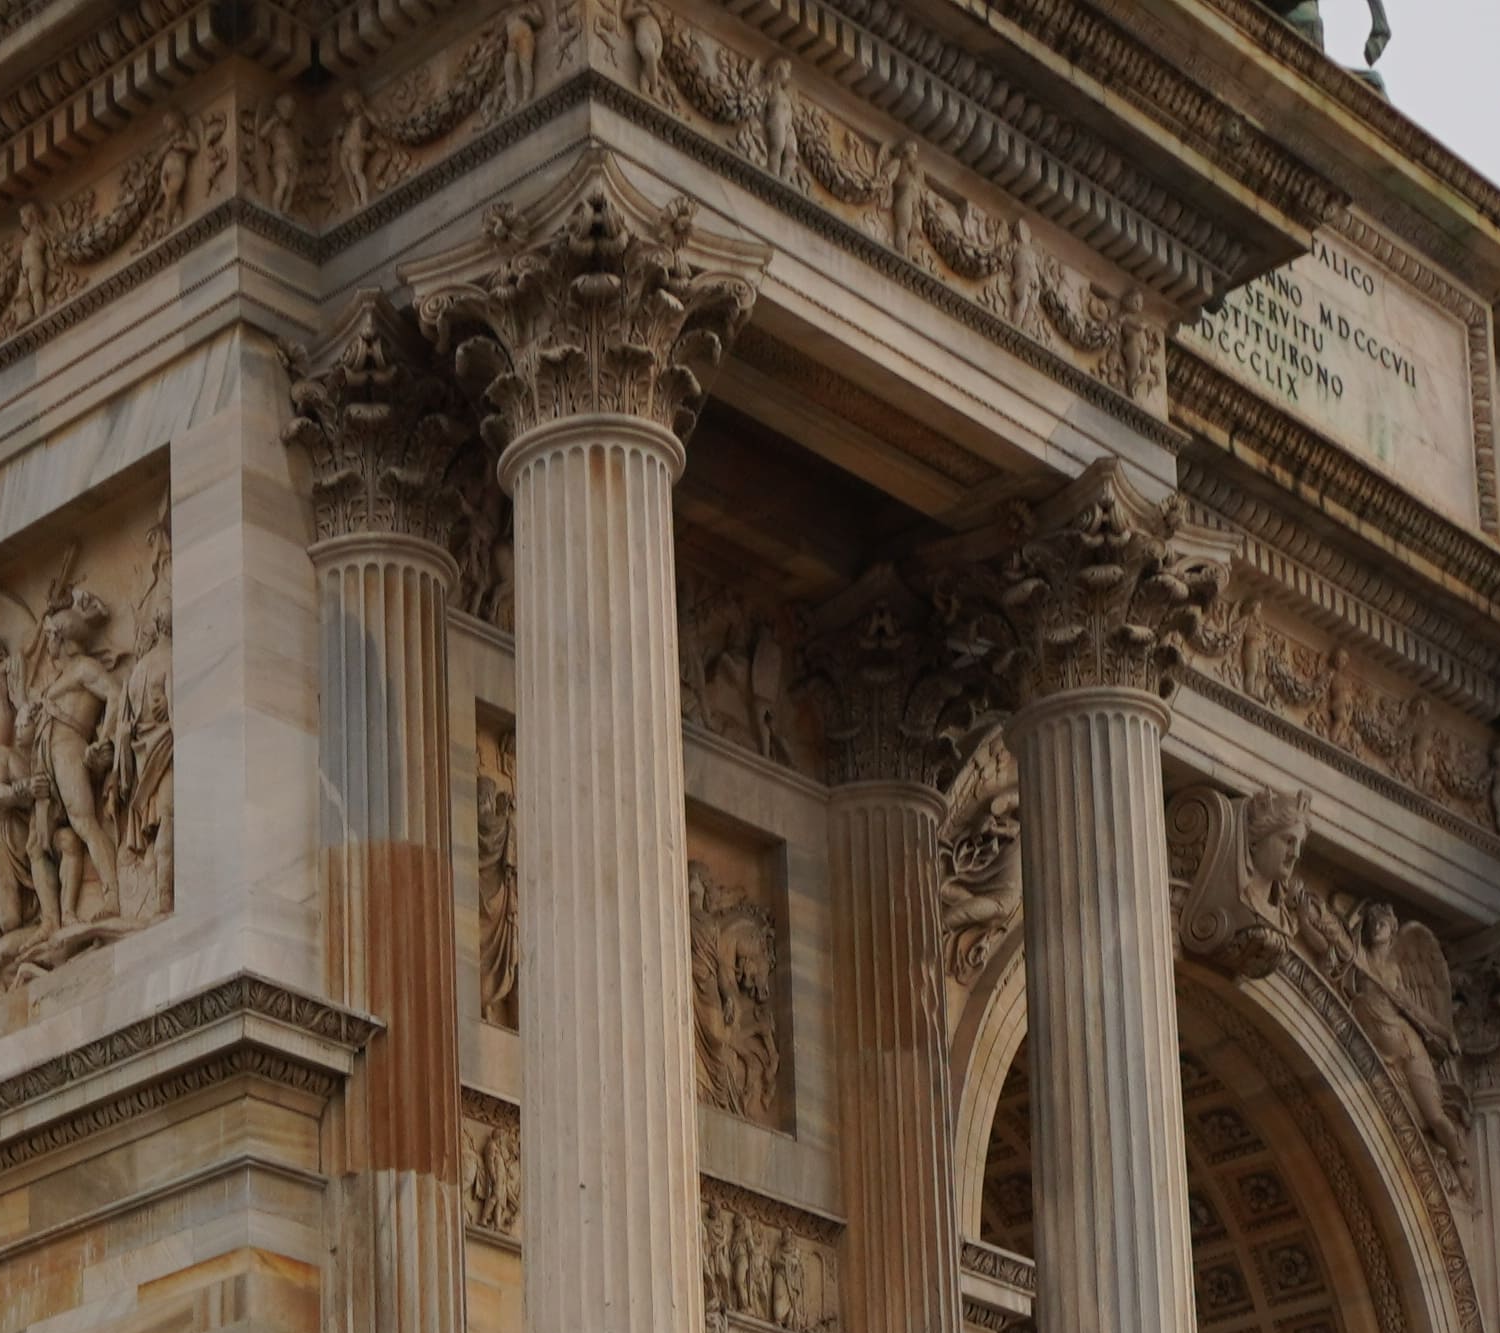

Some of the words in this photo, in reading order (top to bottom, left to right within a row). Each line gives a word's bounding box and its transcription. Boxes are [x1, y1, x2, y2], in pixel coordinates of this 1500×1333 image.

[1192, 318, 1298, 400] DCCCLIX
[1245, 284, 1324, 353] SERVITU
[1258, 268, 1302, 306] NNO
[1319, 301, 1416, 388] MDCCCVII
